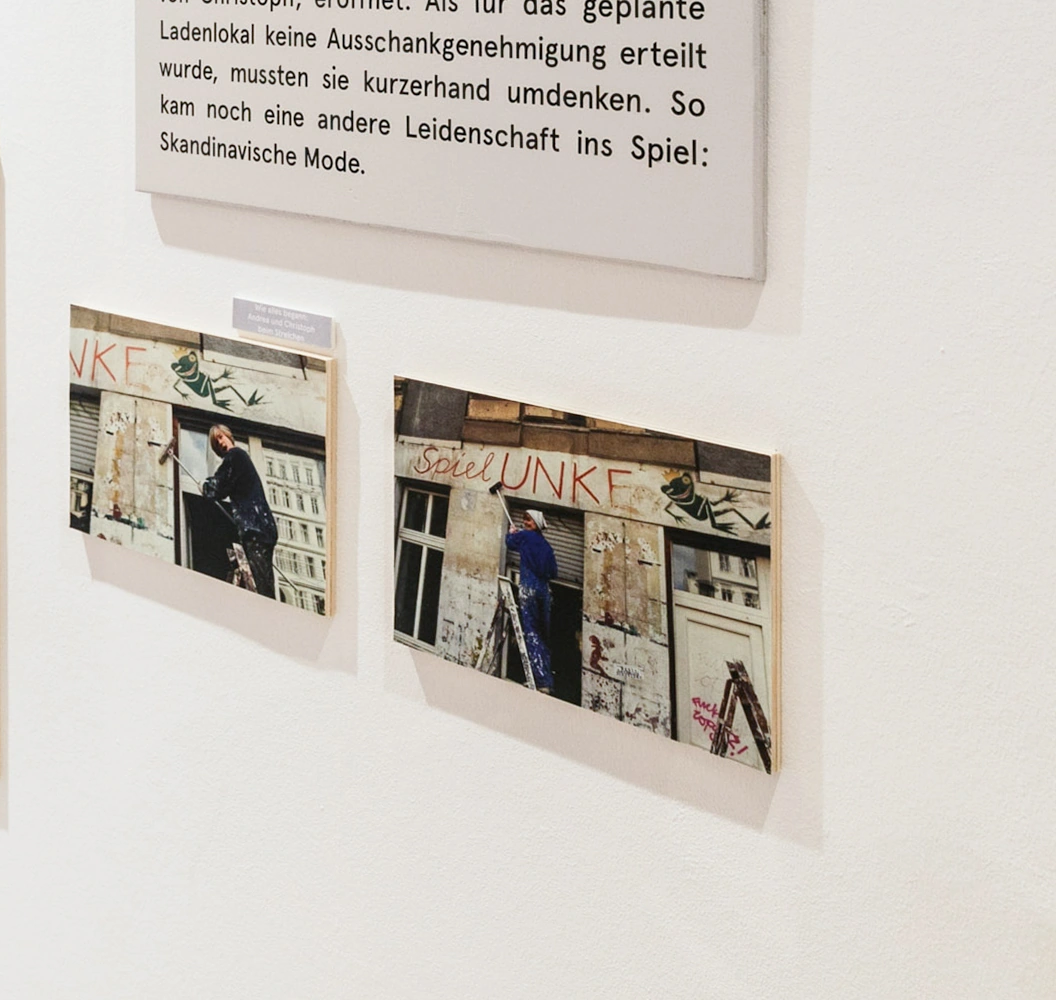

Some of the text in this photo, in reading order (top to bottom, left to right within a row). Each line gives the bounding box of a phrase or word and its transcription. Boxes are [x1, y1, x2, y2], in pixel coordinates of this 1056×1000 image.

[160, 19, 708, 71] Ladenlokal keine Ausschankgenehmigung erteilt
[159, 130, 366, 175] Skandinavische Mode.
[160, 93, 709, 169] kam noch eine andere Leidenschaft ins Spiel:
[247, 312, 317, 335] Andrea und Christoph
